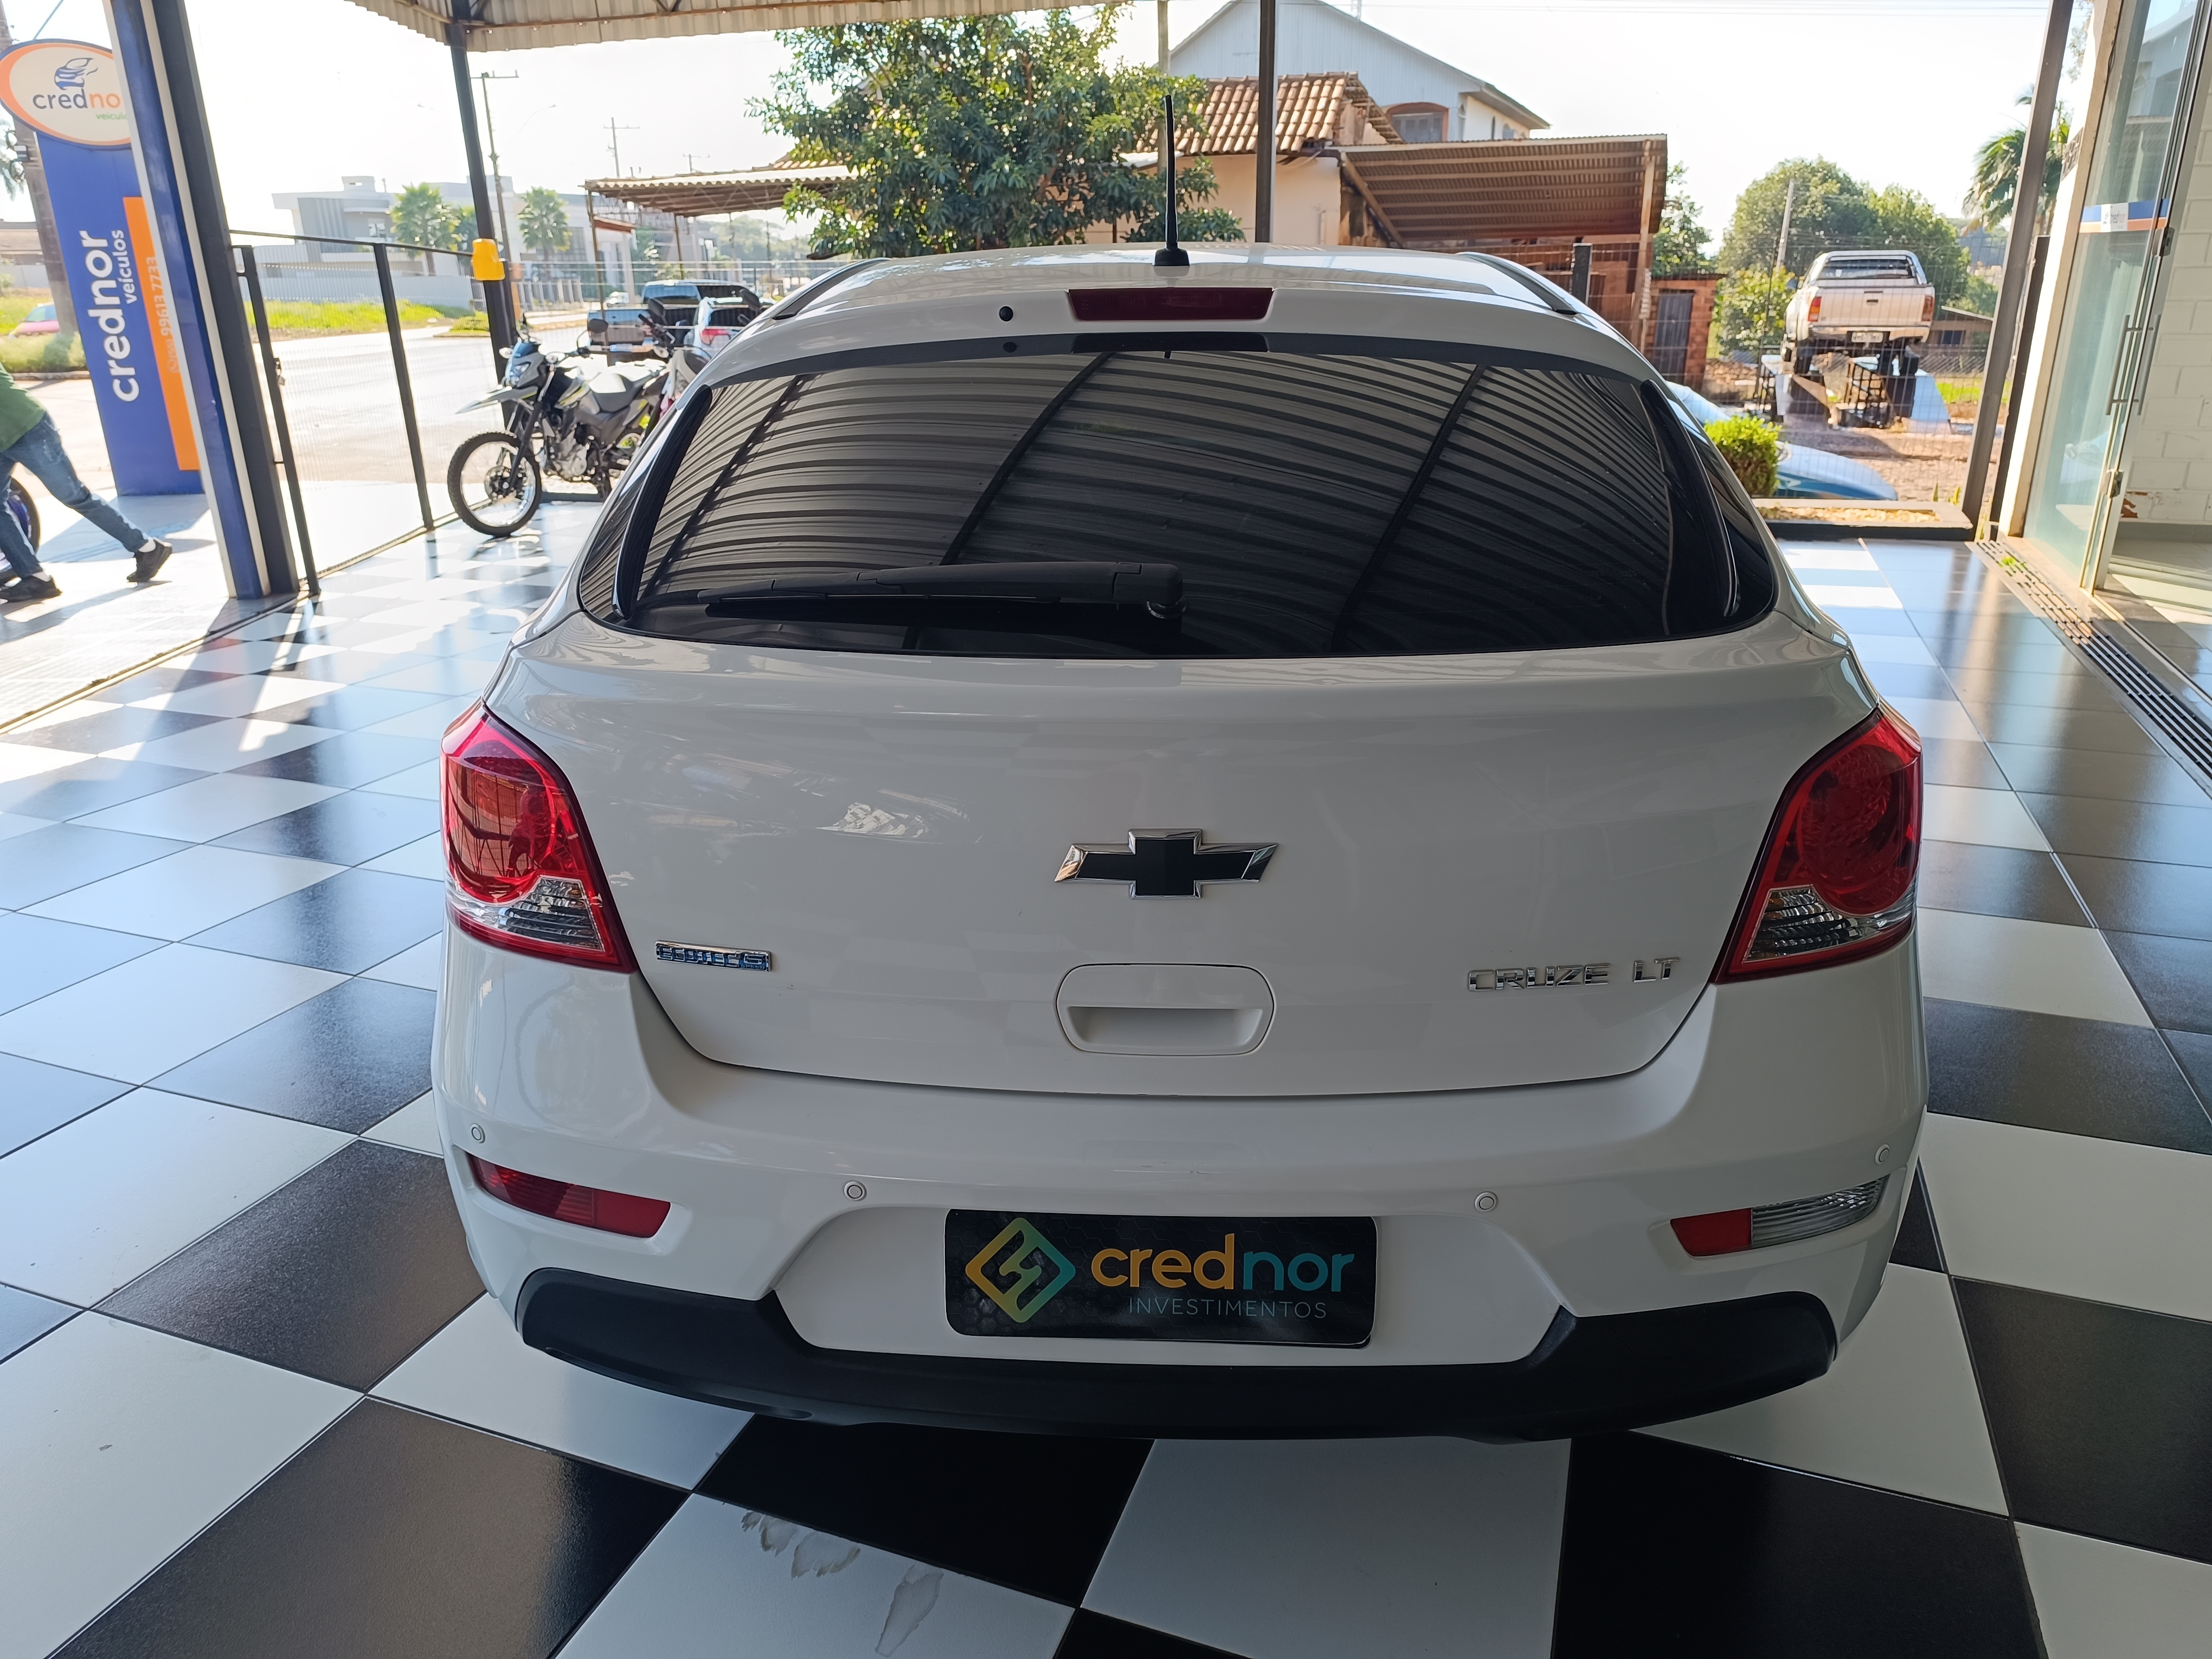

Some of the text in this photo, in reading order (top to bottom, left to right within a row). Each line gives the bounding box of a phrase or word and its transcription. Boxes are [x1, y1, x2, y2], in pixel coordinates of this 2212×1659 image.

[33, 88, 121, 109] credno
[111, 230, 138, 304] veículos
[79, 230, 139, 402] crednor
[659, 946, 740, 967] ECOTEC
[1468, 957, 1680, 992] CRUZE LT
[1091, 1233, 1355, 1292] crednor
[1129, 1297, 1327, 1319] INVESTIMENTOS
